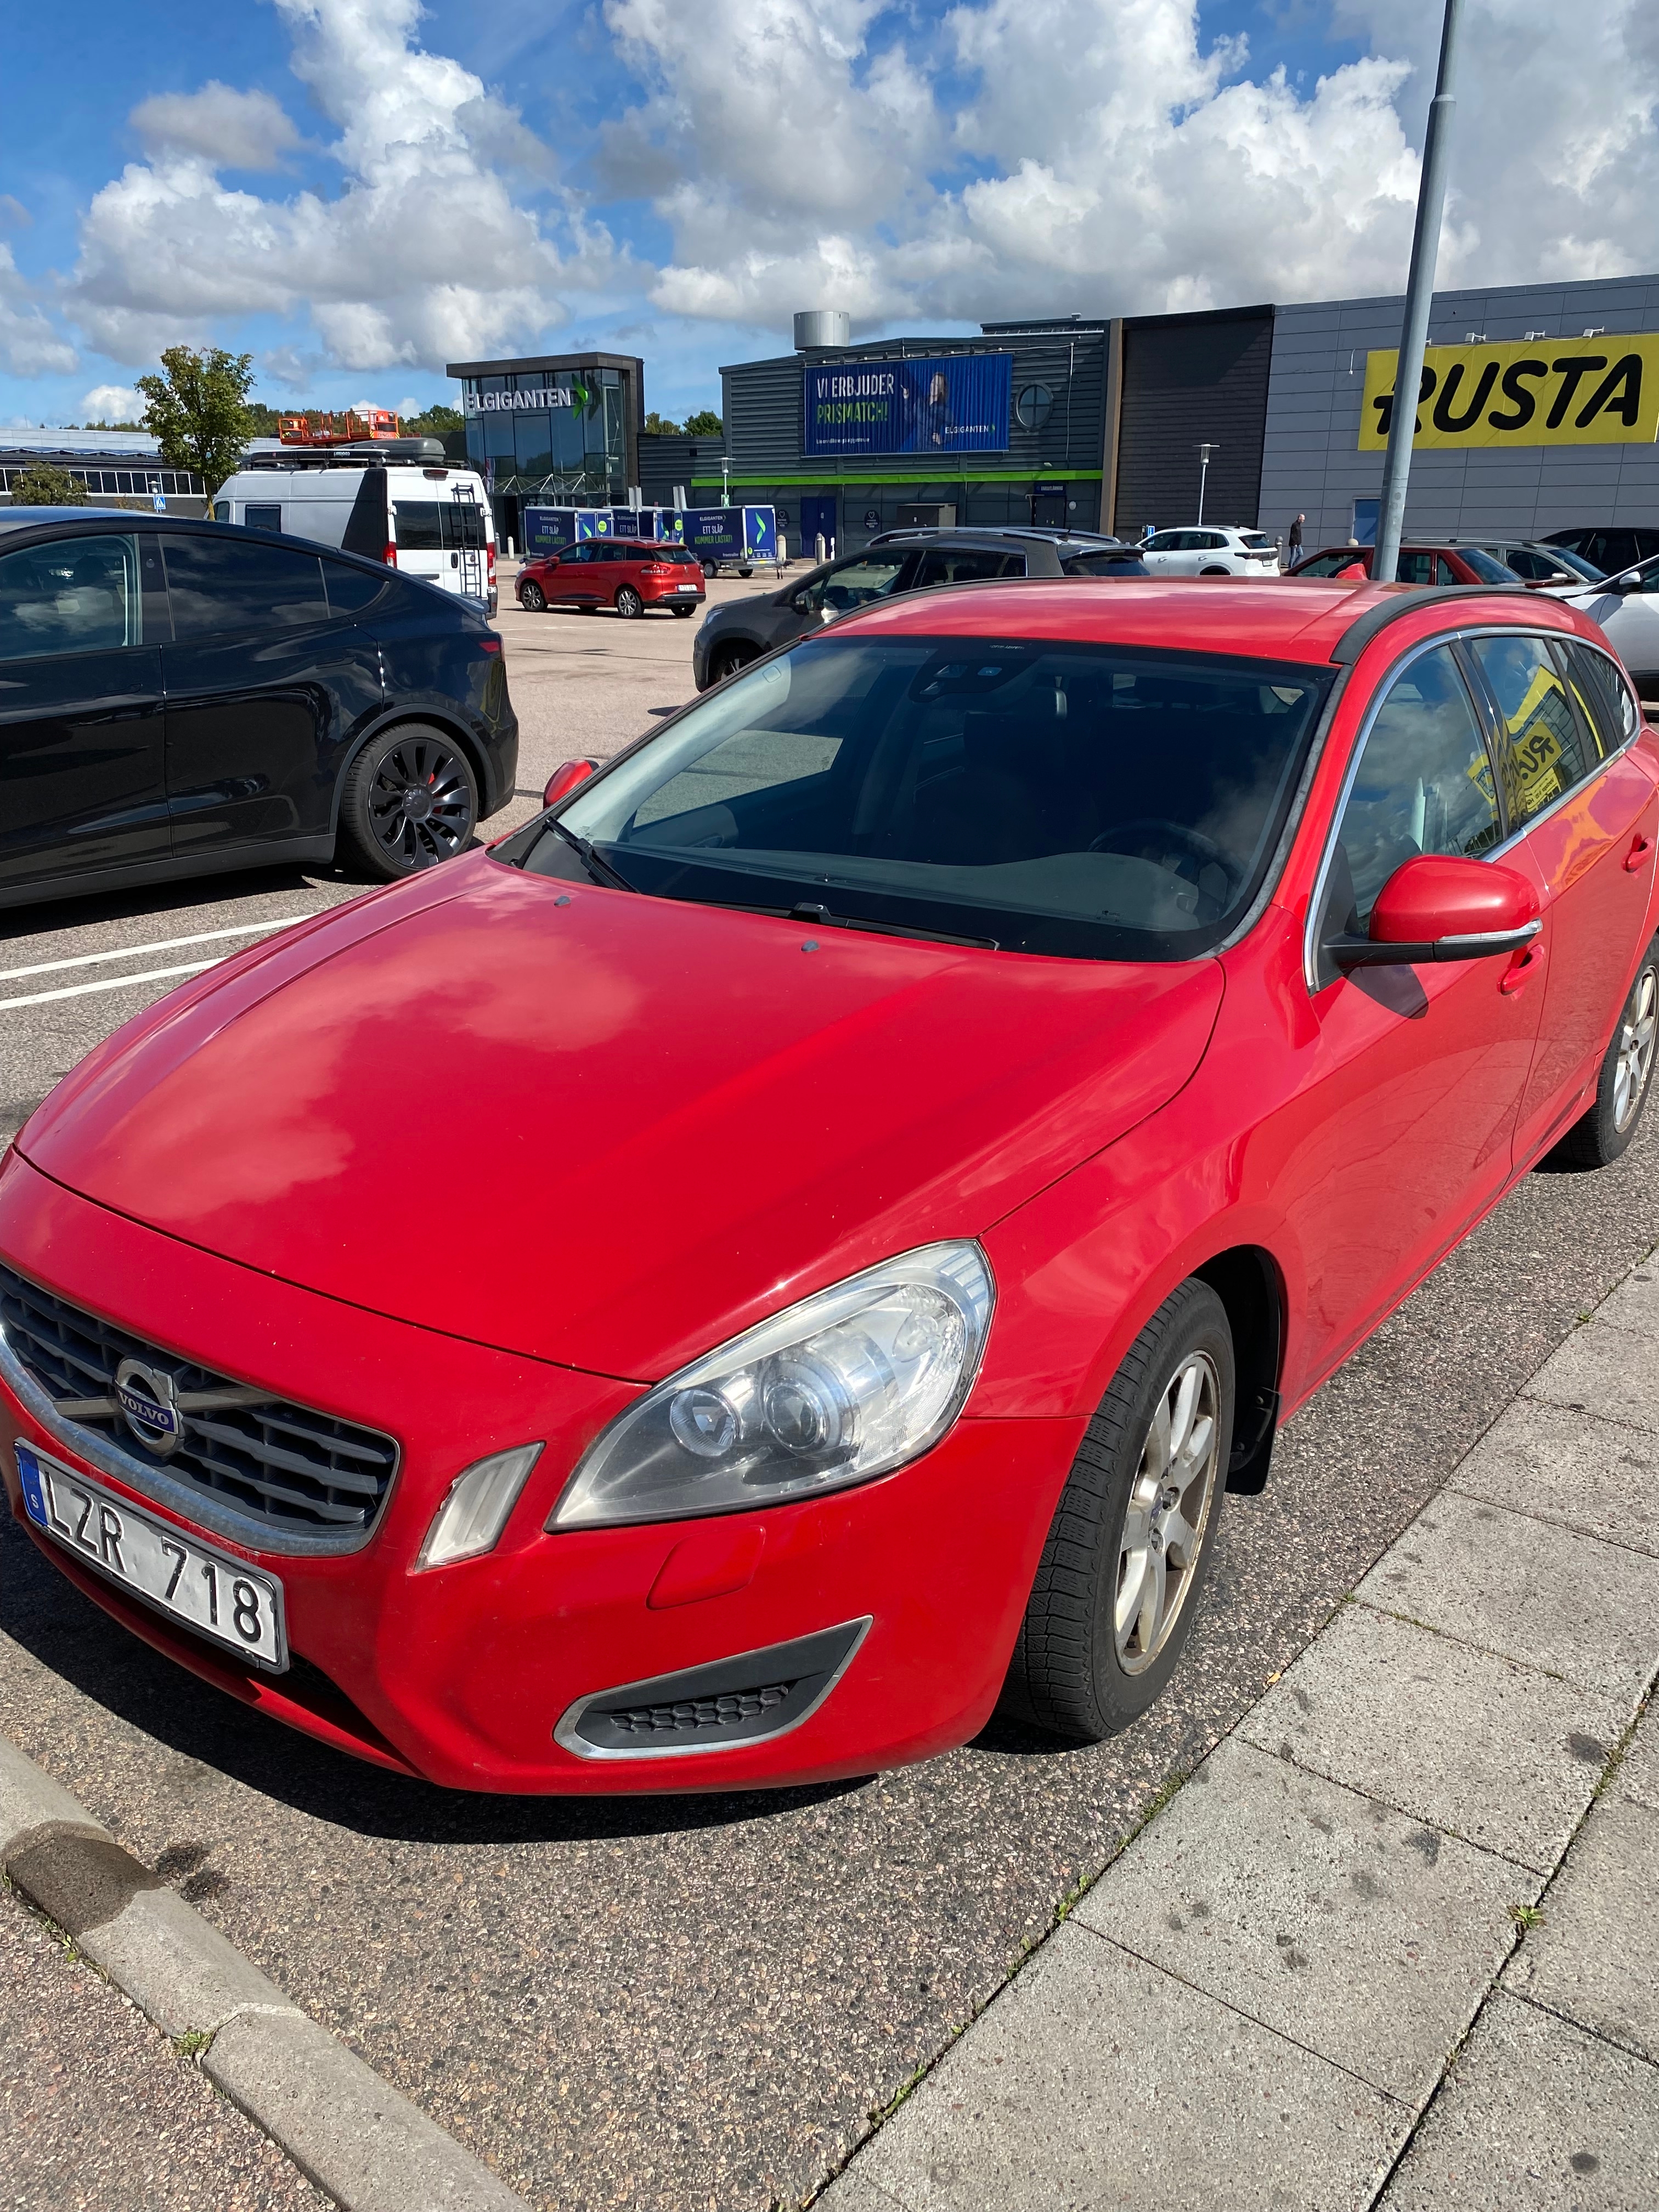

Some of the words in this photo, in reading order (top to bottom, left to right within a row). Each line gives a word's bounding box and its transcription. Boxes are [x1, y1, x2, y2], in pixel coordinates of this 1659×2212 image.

[817, 377, 828, 399] VI
[832, 373, 894, 398] ERBJUDER
[1373, 354, 1643, 435] RUSTA
[467, 387, 571, 412] ELGIGANTEN
[817, 401, 888, 424] PRISMATCH!
[945, 425, 989, 434] ELGIGANTEN
[695, 535, 714, 544] KOMMER
[702, 526, 711, 534] ETT
[118, 1390, 169, 1425] VOLVO
[31, 1493, 39, 1509] S
[44, 1470, 127, 1573] LZR
[161, 1536, 264, 1644] 718
